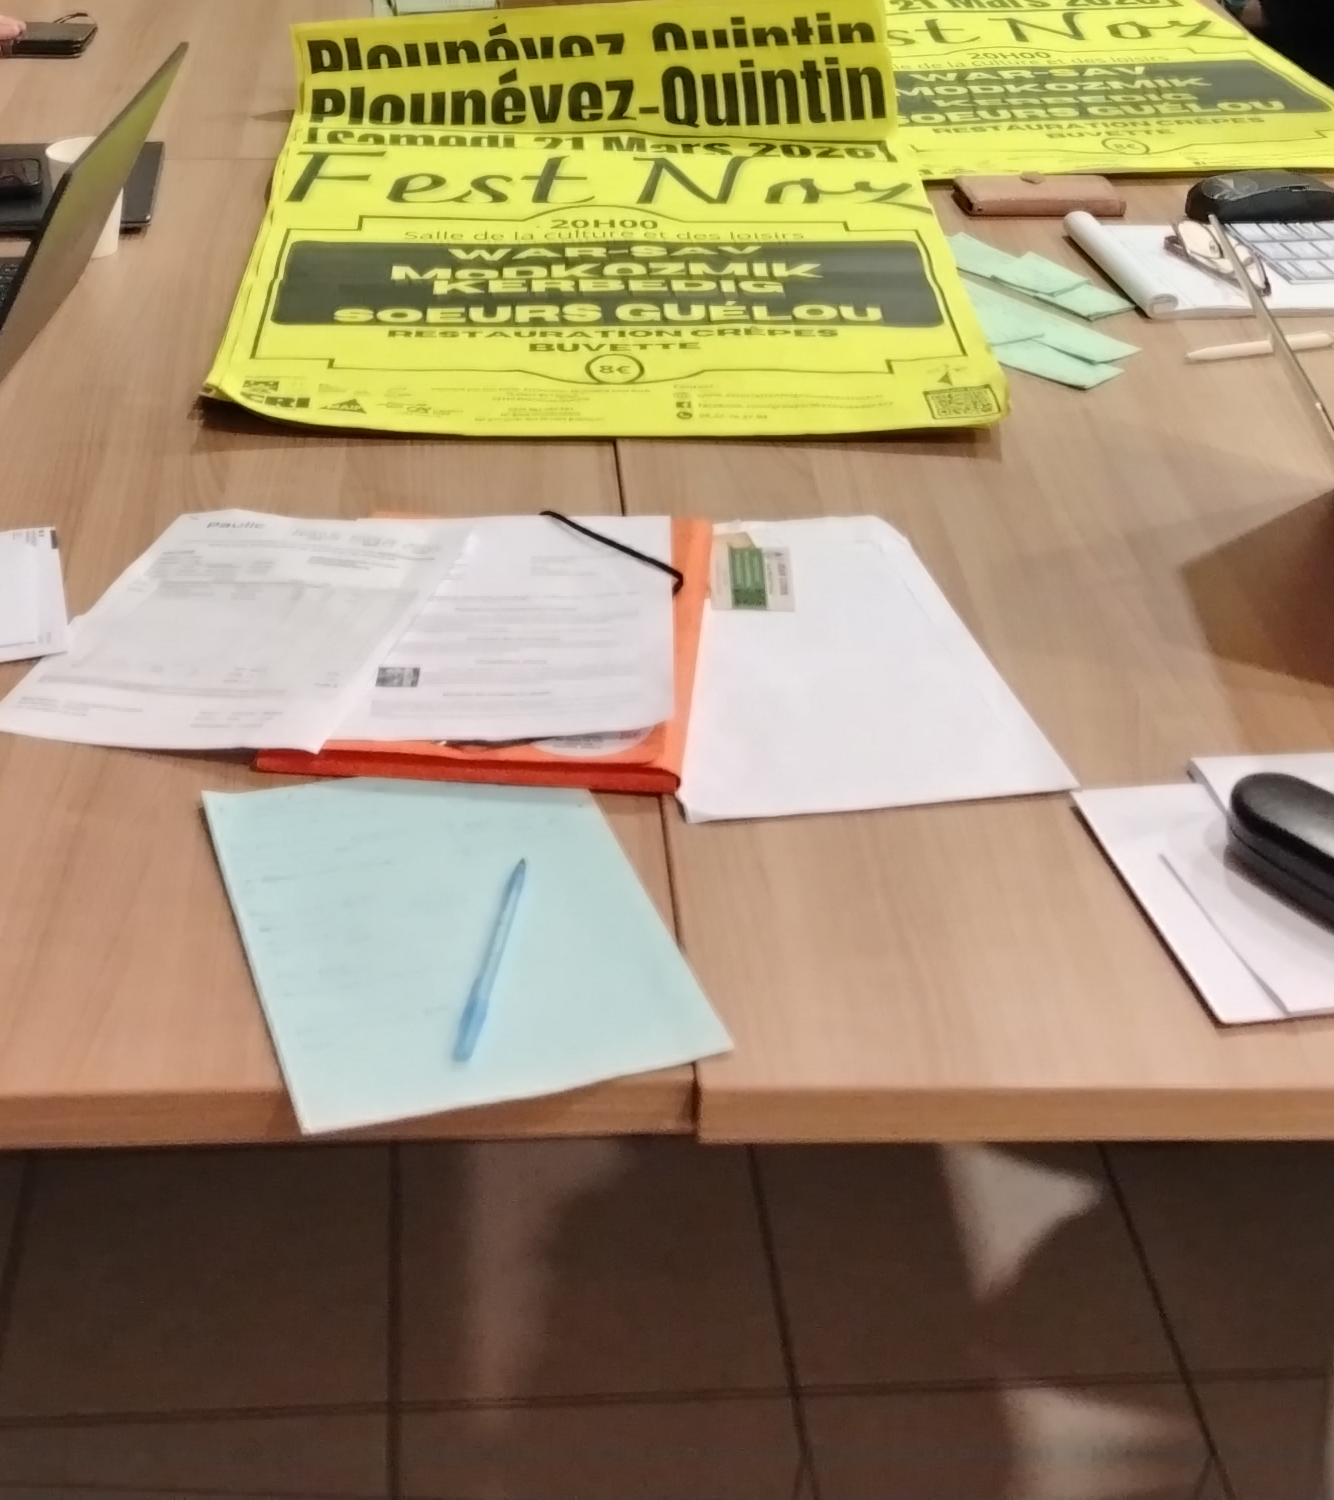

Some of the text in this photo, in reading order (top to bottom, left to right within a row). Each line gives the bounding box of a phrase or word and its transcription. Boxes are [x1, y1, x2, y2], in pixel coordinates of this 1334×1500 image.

[987, 11, 1249, 43] Noz
[918, 62, 942, 70] de
[970, 57, 1041, 67] culture
[1046, 57, 1066, 65] et
[1076, 56, 1109, 64] des
[1111, 54, 1170, 63] loisirs
[967, 52, 1051, 60] 20H00
[909, 66, 1145, 82] WAR-SAV
[310, 57, 886, 128] Plounévez-Quintin
[896, 78, 1213, 97] MODKOZMIK
[932, 93, 1199, 108] KERBEDIG
[1088, 100, 1286, 116] GUÉLOU
[932, 116, 1266, 134] RESTAURATION CRÊPES
[1046, 129, 1176, 139] BUVETTE
[533, 136, 584, 150] 21
[602, 136, 733, 155] Mars
[748, 142, 876, 158] 2026
[284, 151, 933, 215] Fest Noz
[550, 219, 659, 229] 20H00
[404, 229, 805, 241] Salle de la culture et des loisirs
[448, 245, 762, 261] WAR-SAV
[390, 262, 823, 280] MODKOZMIK
[433, 279, 785, 295] KERBEDIG
[333, 300, 883, 323] SOEURS GUÉLOU
[387, 326, 839, 338] RESTAURATION CRÊPES
[529, 342, 701, 352] BUVETTE
[599, 365, 632, 374] 8€
